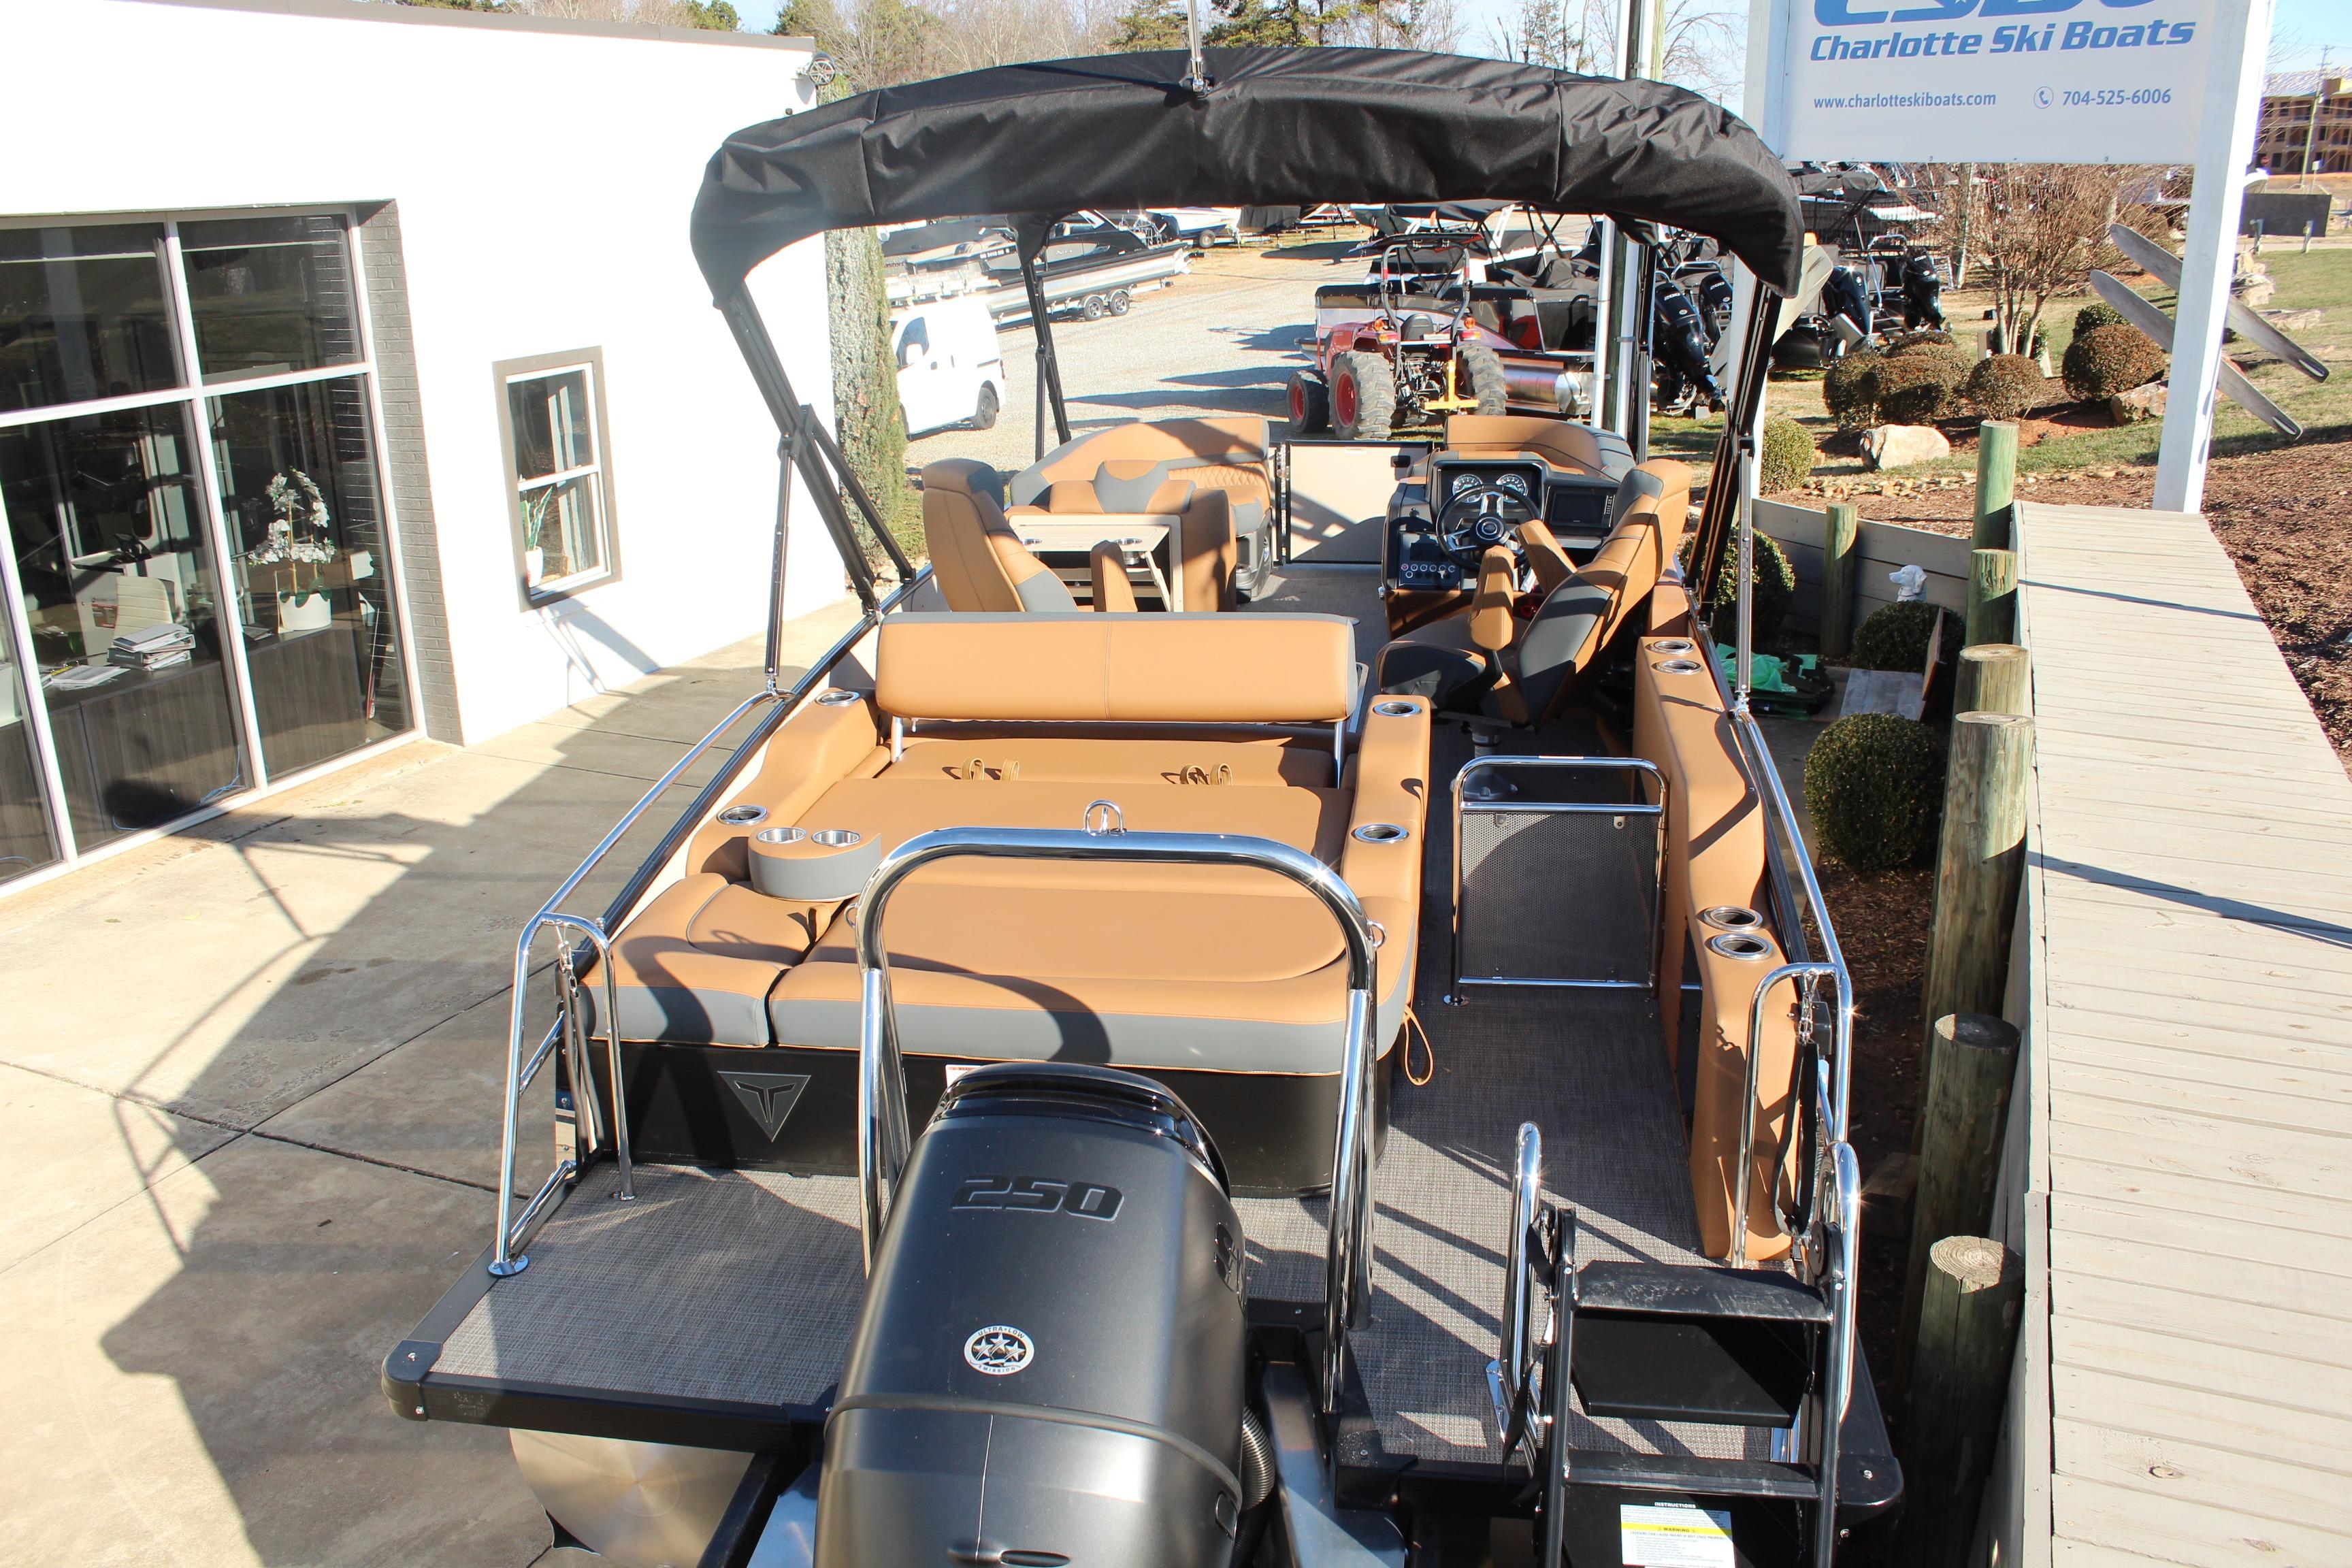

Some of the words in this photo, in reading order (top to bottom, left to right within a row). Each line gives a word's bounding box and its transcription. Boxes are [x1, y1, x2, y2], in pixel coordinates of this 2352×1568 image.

[1810, 32, 1982, 61] Charlotte
[1989, 23, 2057, 53] Ski
[2060, 19, 2196, 50] Boats
[1814, 92, 1996, 109] www.charlotteskiboats.com
[2062, 88, 2172, 105] 704-525-6006
[950, 1175, 1124, 1222] 250
[977, 1326, 1002, 1337] ULTRA
[1008, 1328, 1025, 1339] LOW
[979, 1365, 1015, 1373] EMISSION
